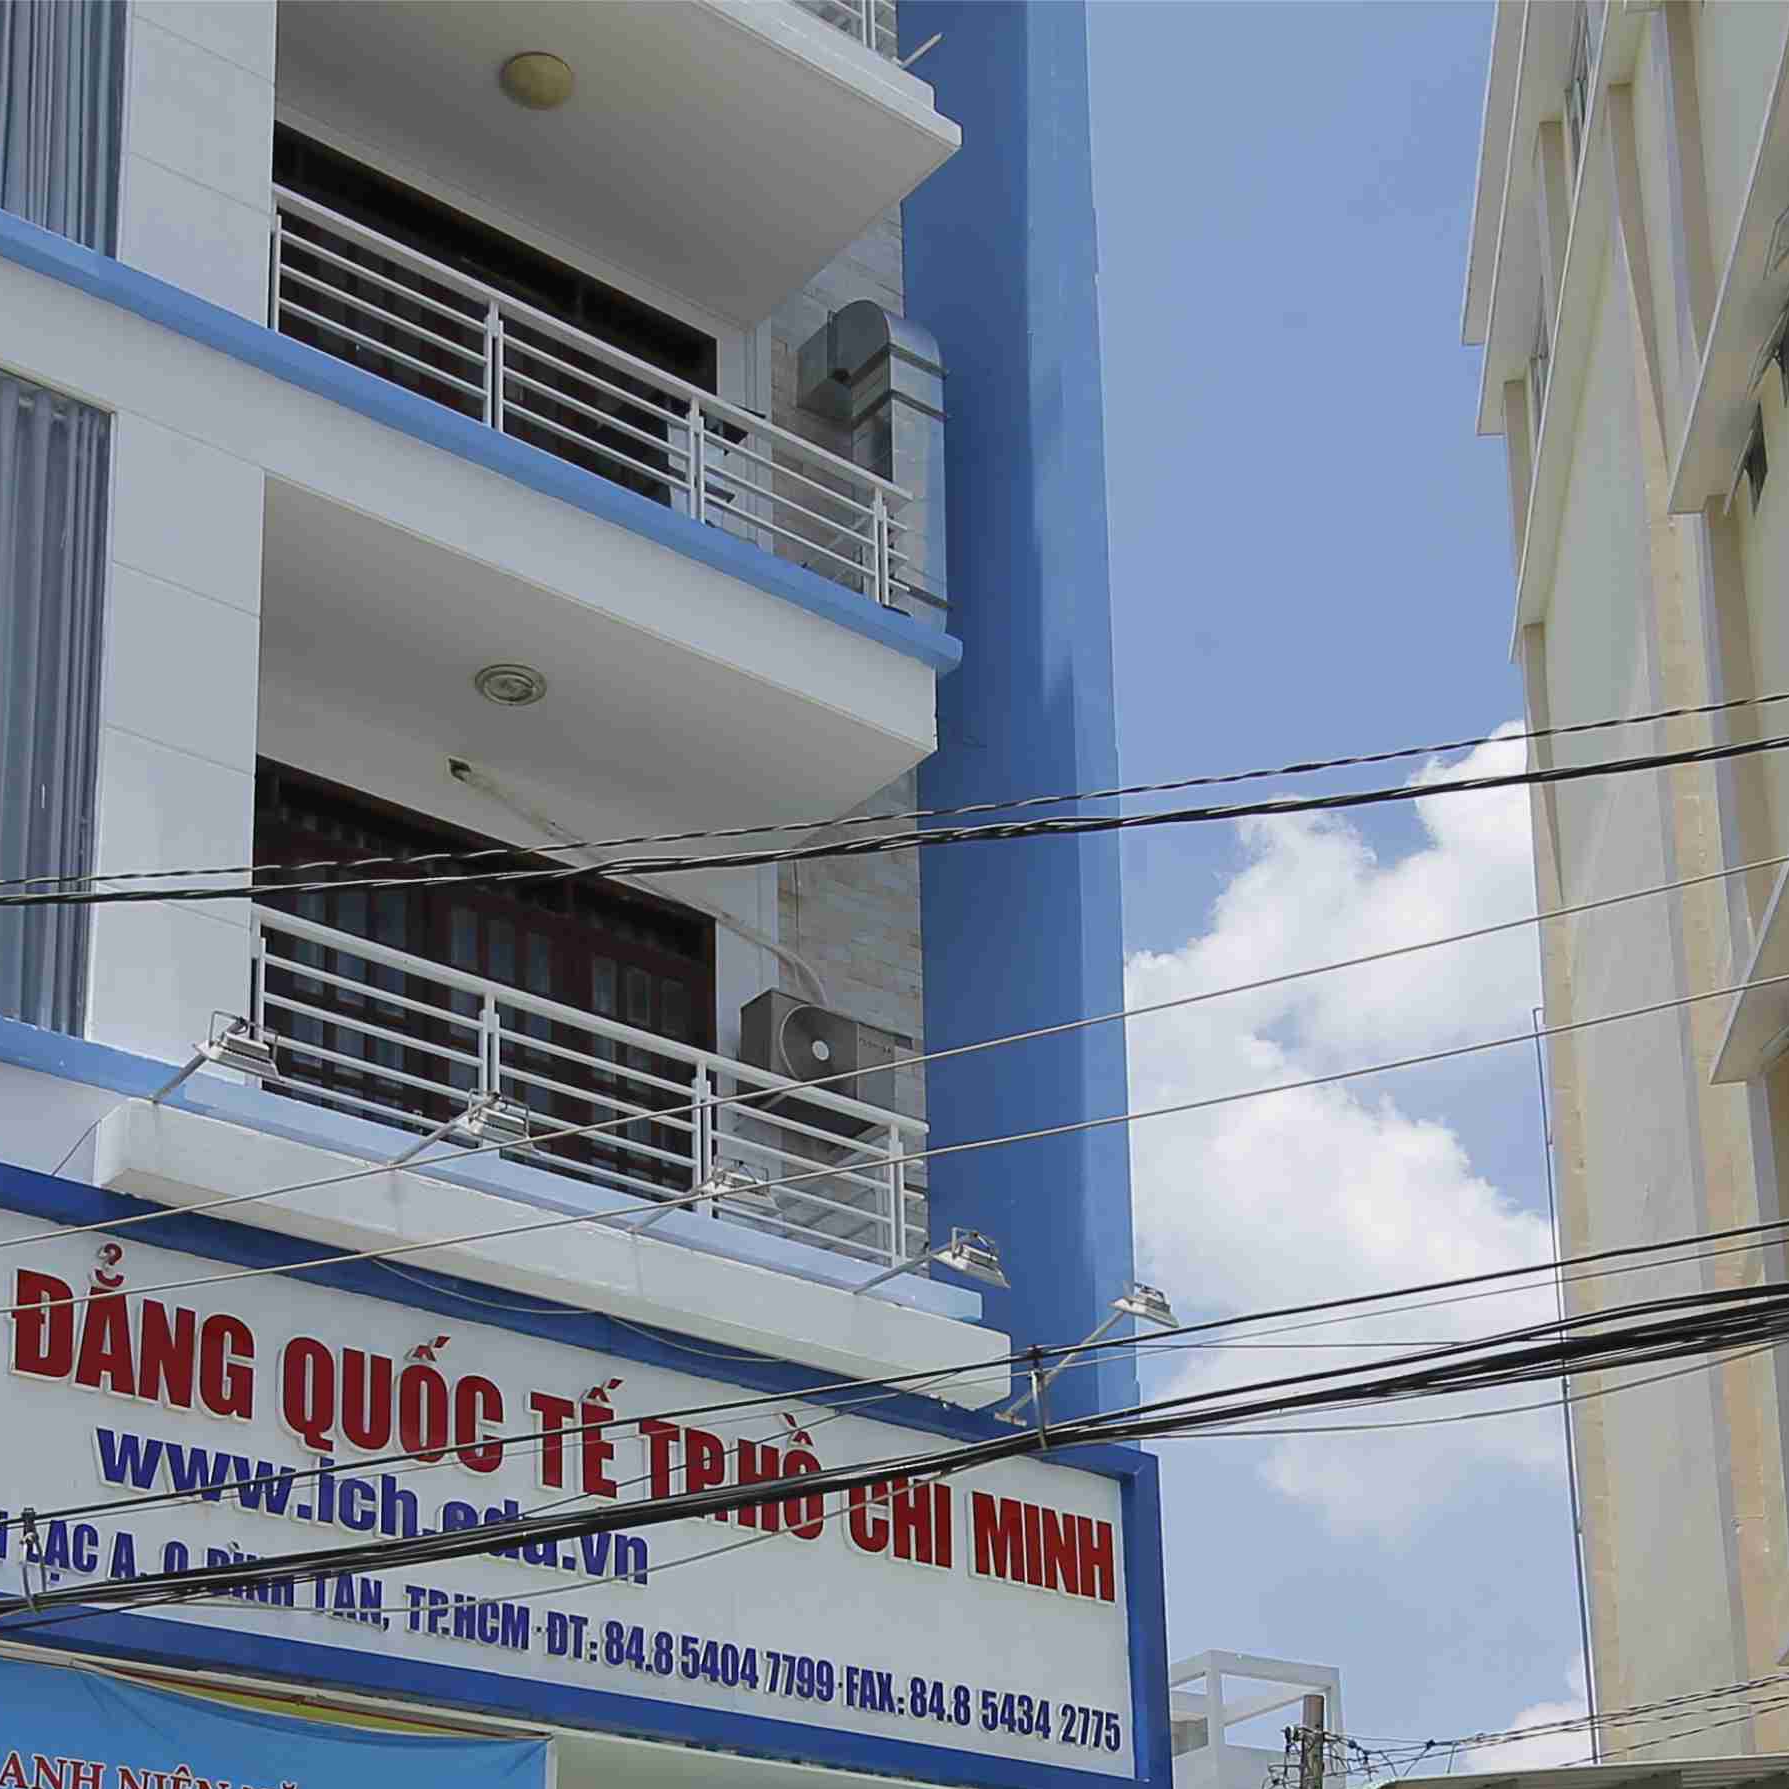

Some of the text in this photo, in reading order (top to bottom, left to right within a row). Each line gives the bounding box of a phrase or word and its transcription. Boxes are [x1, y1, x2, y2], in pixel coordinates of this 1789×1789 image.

[11, 1242, 256, 1421] ĐẲNG
[283, 1336, 505, 1474] QUỐC
[530, 1379, 624, 1499] TẾ
[971, 1490, 1116, 1603] MINH
[681, 1634, 759, 1690] 5404
[766, 1650, 835, 1703] 7799
[910, 1676, 972, 1727] 84.8
[981, 1689, 1052, 1740] 5434
[1061, 1703, 1121, 1752] 2775
